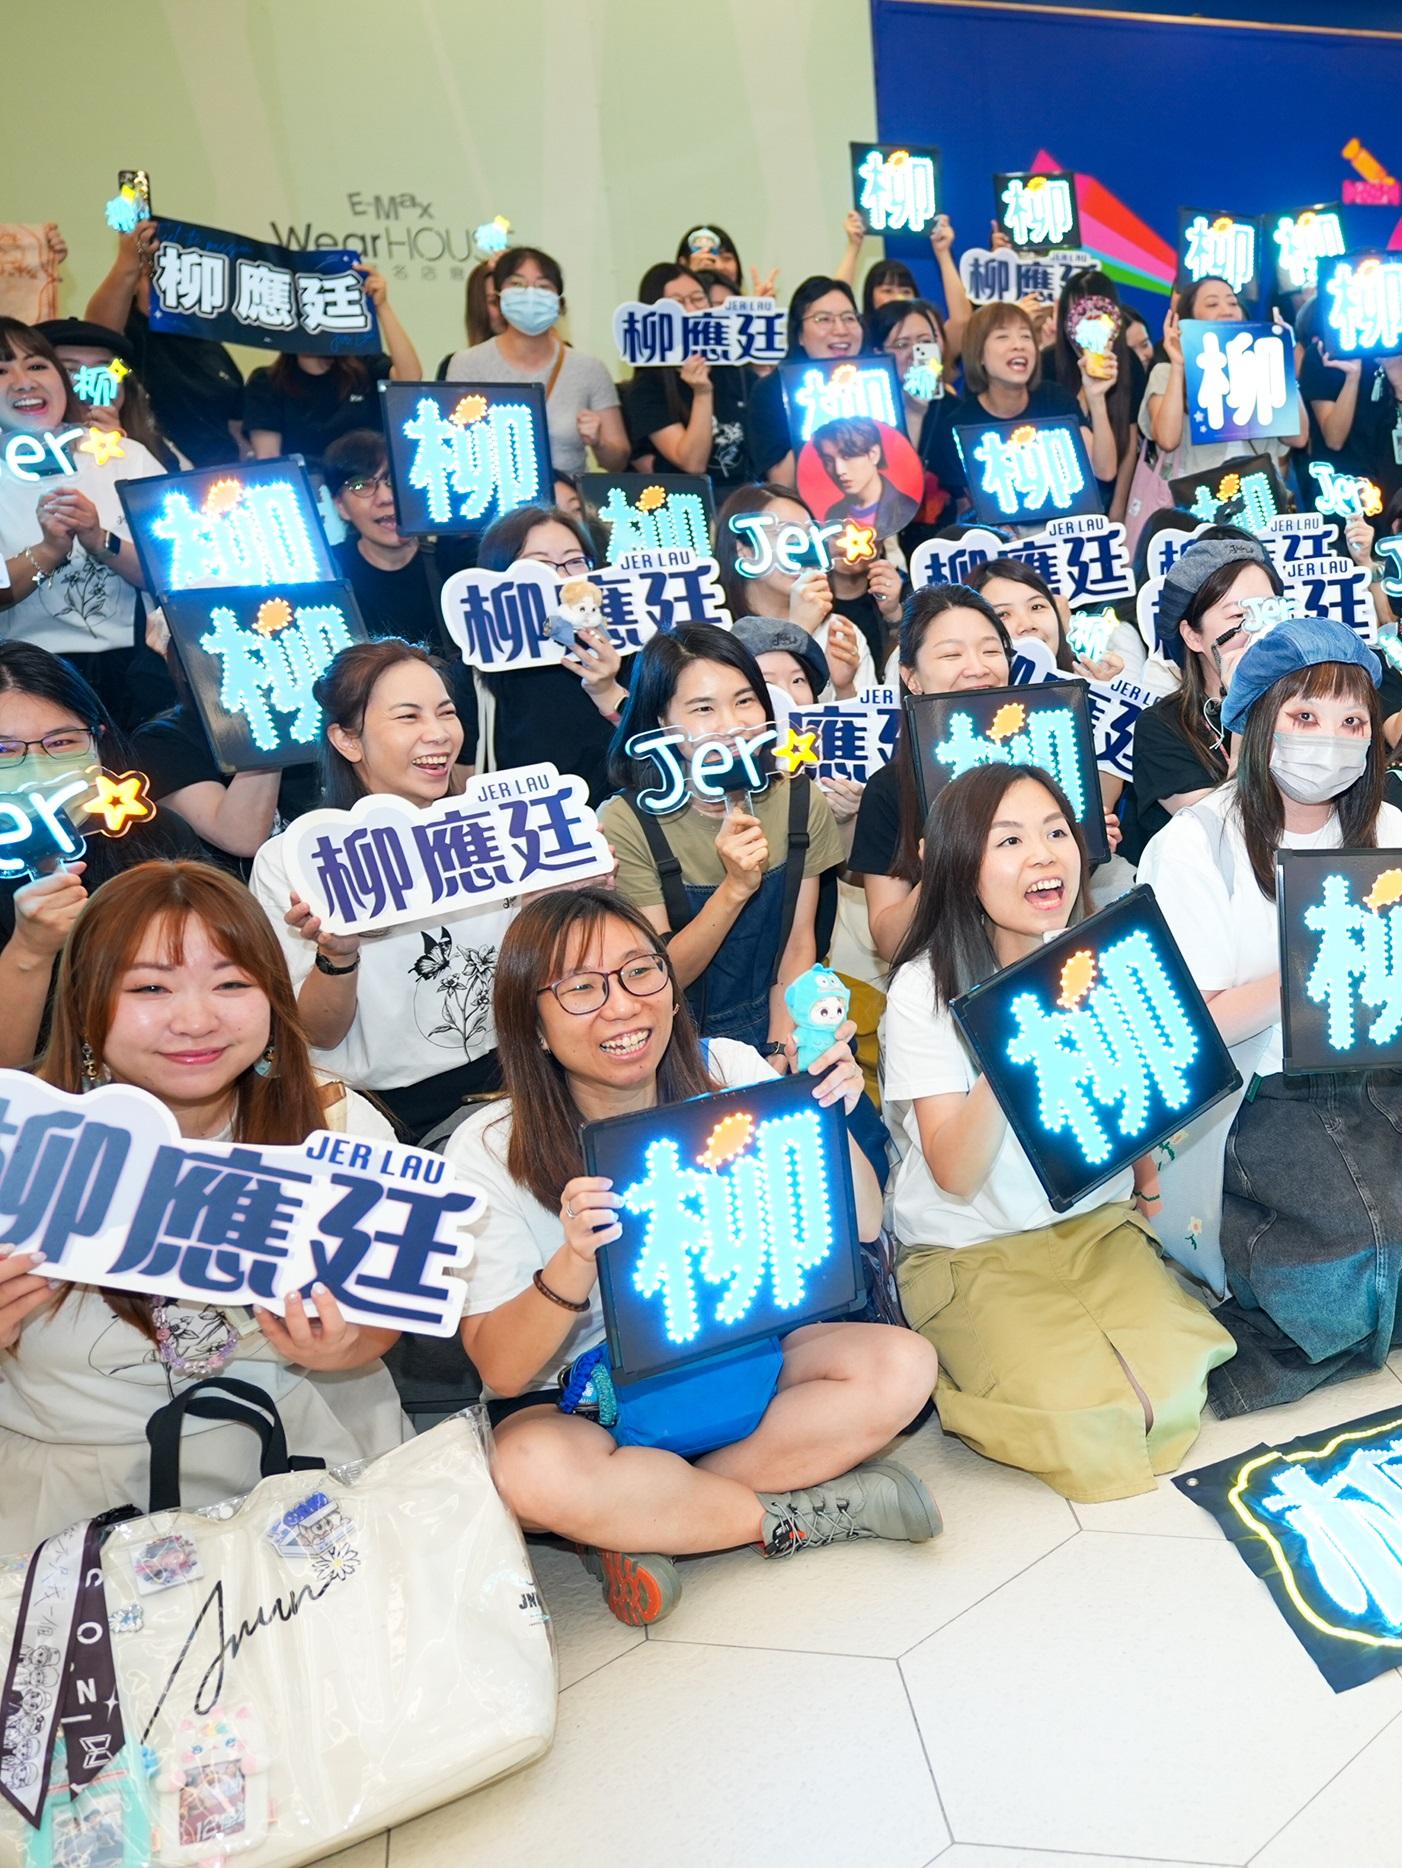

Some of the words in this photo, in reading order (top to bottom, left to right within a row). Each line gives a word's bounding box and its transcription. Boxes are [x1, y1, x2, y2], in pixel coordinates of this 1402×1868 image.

[858, 150, 936, 232] 柳
[1002, 178, 1074, 246] 柳
[271, 221, 508, 263] WearHOU
[1184, 216, 1256, 293] 柳
[158, 245, 368, 331] 柳應廷
[725, 301, 748, 311] JER
[752, 302, 772, 311] LAU
[622, 311, 787, 364] 柳應廷
[72, 365, 120, 407] 柳
[1195, 331, 1288, 431] 柳
[0, 427, 85, 482] er
[403, 397, 541, 523] 柳
[973, 426, 1085, 514] 柳
[152, 480, 322, 590] 柳
[730, 512, 843, 576] Jer
[1049, 521, 1074, 536] JER
[1079, 517, 1104, 532] LAU
[1271, 519, 1295, 532] JER
[1297, 517, 1320, 530] LAU
[621, 554, 652, 570] JER
[659, 551, 692, 567] LAU
[1287, 561, 1317, 578] JER
[1320, 559, 1348, 576] LAU
[201, 597, 353, 752] 柳
[860, 689, 893, 704] JER
[1110, 680, 1142, 699] JER
[478, 783, 512, 802] JER
[517, 775, 551, 795] LAU
[636, 730, 778, 809] Jer
[0, 780, 89, 872] er
[311, 787, 598, 924] 柳應廷
[1008, 929, 1199, 1164] 柳
[305, 1135, 371, 1171] JER
[380, 1149, 446, 1186] LAU
[0, 1097, 477, 1324] 柳應廷
[624, 1110, 832, 1344] 柳
